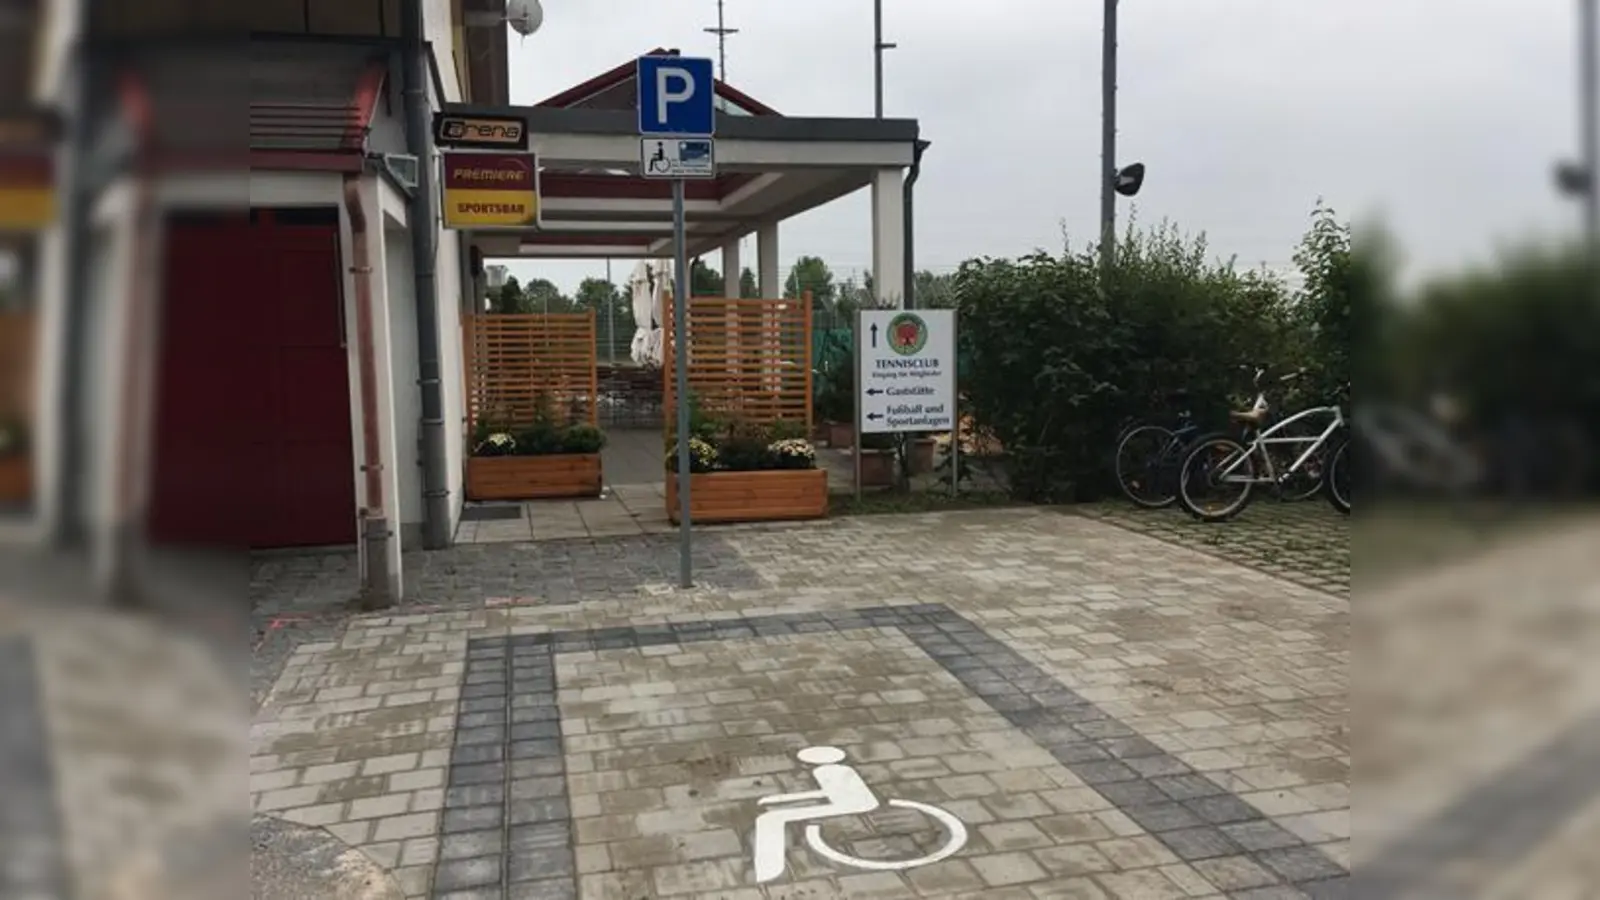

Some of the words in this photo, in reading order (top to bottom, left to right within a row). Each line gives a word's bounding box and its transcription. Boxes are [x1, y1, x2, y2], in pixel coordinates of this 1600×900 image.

[656, 67, 695, 124] P
[453, 168, 526, 181] PREMIERE
[457, 203, 525, 214] SPORTSBAR
[875, 358, 940, 369] TENNISCLUB
[886, 386, 935, 396] Gaststätte
[886, 403, 923, 415] Fußball
[925, 403, 944, 414] und
[886, 416, 950, 428] Sportanlagen
